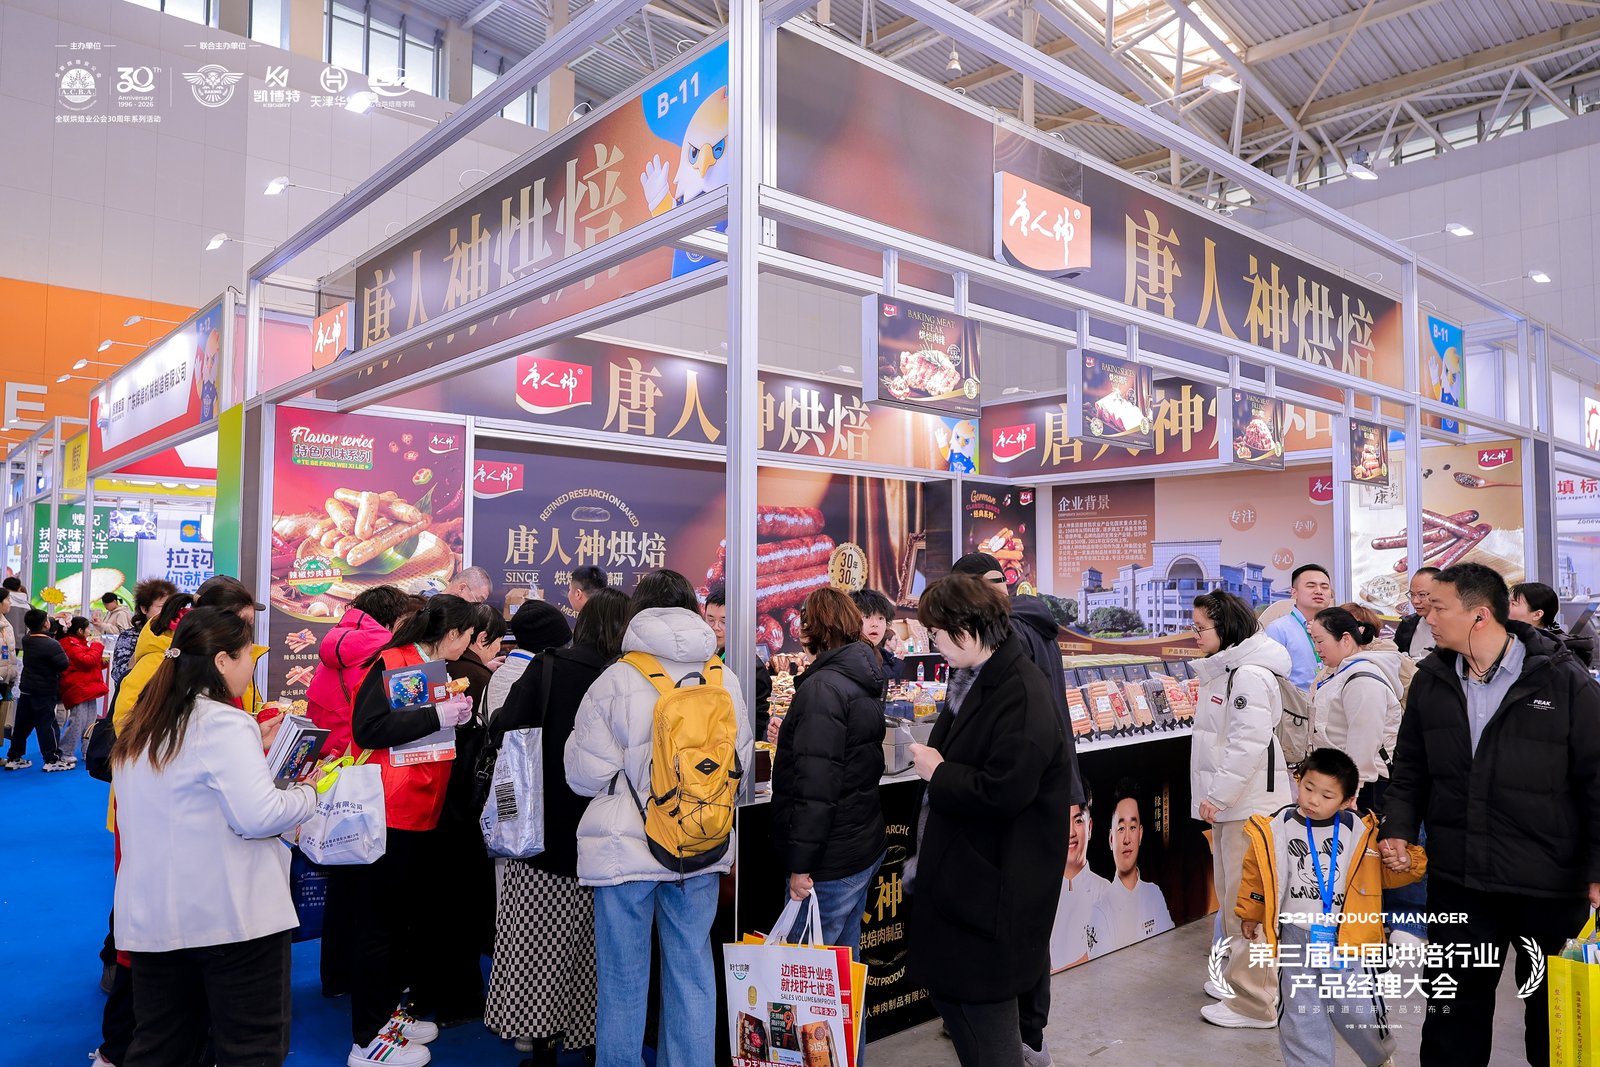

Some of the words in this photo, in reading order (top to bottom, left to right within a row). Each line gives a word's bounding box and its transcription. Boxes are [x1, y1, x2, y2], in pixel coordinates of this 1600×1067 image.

[656, 71, 701, 119] B-11
[1008, 188, 1076, 266] 唐人神
[1124, 208, 1376, 381] 唐人神烘焙
[907, 309, 936, 324] BAKING
[936, 316, 955, 329] MEAT
[921, 321, 944, 334] STEAK
[1433, 323, 1449, 343] B-11
[521, 361, 579, 403] 唐人神
[4, 381, 48, 431] E
[291, 426, 338, 444] Flavor
[340, 434, 375, 448] series
[993, 427, 1029, 455] 唐人神
[295, 445, 372, 463] 特色风味系列
[473, 464, 514, 491] 唐人神
[1312, 479, 1333, 493] 唐人
[970, 490, 997, 505] German
[1058, 494, 1110, 512] 企业背景
[539, 493, 570, 522] REFINED
[568, 488, 610, 501] RESEARCH
[608, 493, 621, 506] ON
[618, 502, 640, 529] BAKED
[1231, 509, 1255, 524] 专注
[1294, 519, 1315, 532] 专业
[504, 524, 667, 569] 唐人神烘焙
[166, 547, 214, 569] 拉钩
[1273, 553, 1293, 566] 专心
[505, 572, 539, 583] SINCE
[560, 604, 580, 619] MEAT
[859, 922, 905, 951] 烘焙肉制品
[781, 963, 834, 982] 边柜提升业绩
[780, 993, 795, 1001] SALES
[781, 978, 836, 998] 就找好七优趣
